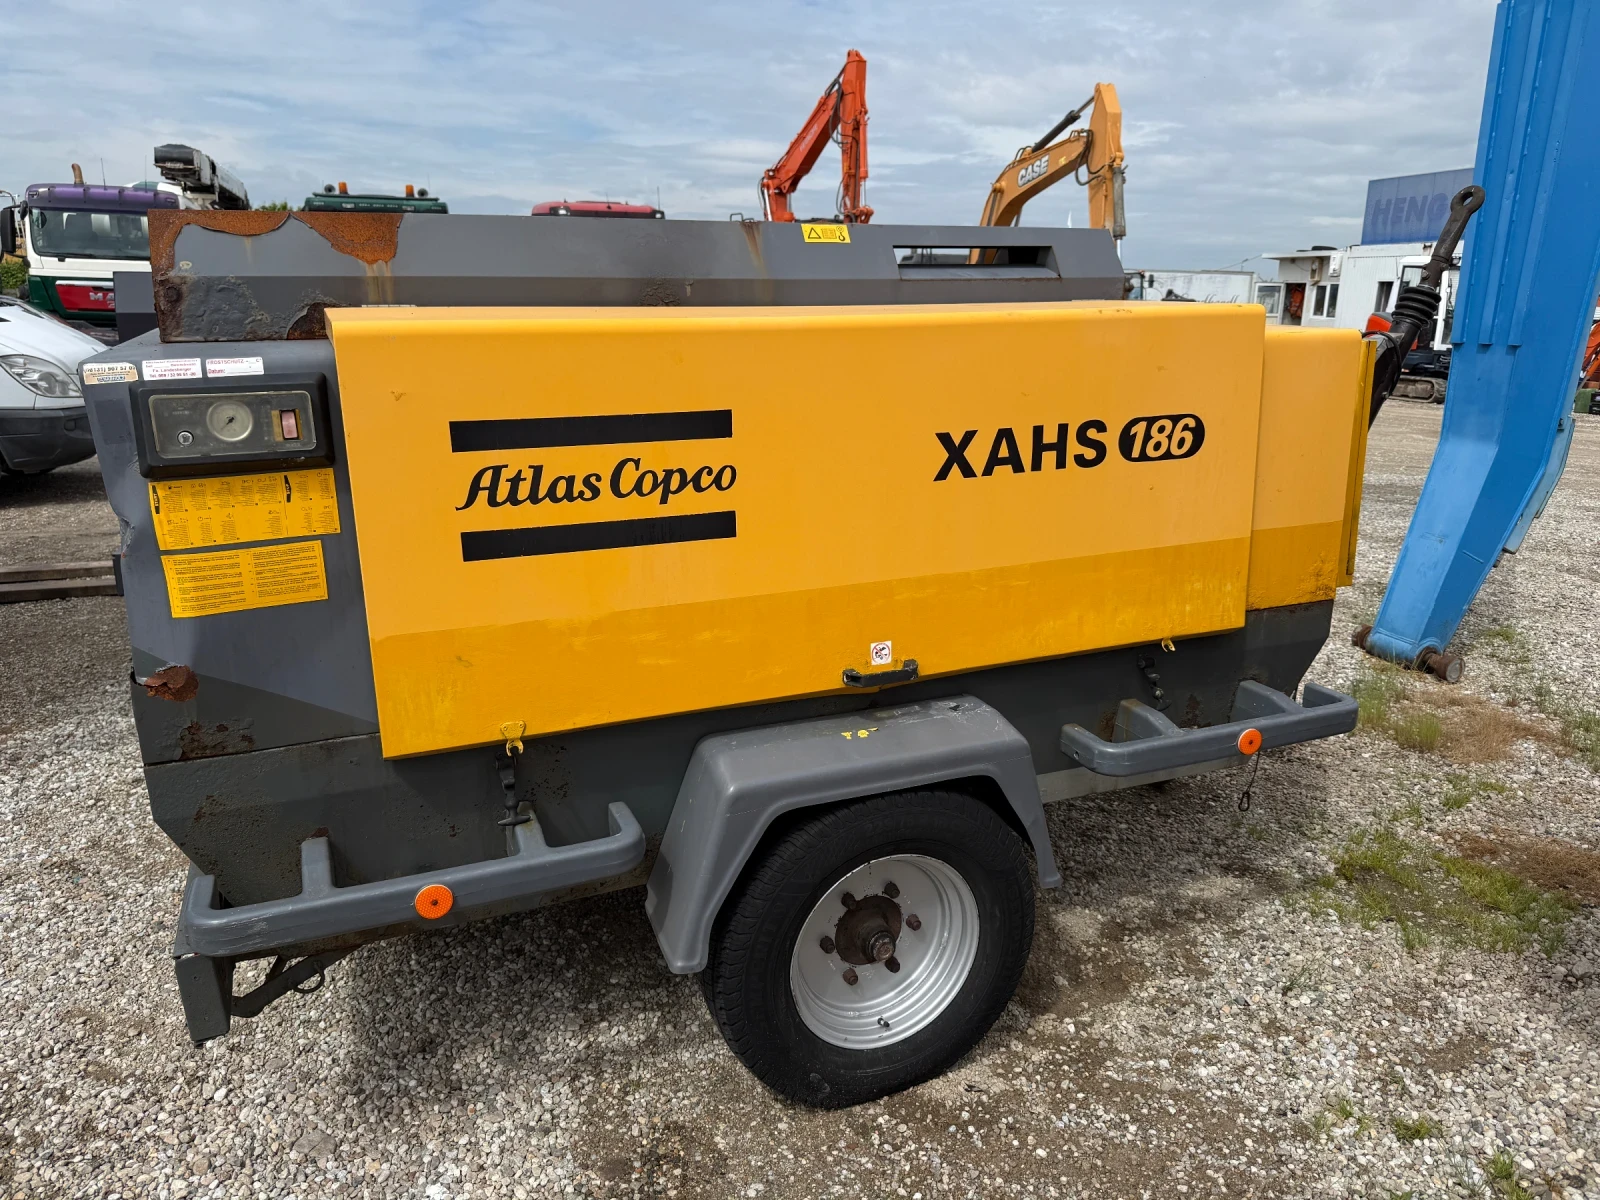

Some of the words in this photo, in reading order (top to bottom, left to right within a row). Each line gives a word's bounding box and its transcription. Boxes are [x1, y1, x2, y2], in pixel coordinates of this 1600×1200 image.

[1018, 155, 1050, 188] CASE
[933, 419, 1108, 482] XAHS
[1128, 417, 1197, 459] 186
[455, 464, 603, 511] Atlas
[609, 457, 737, 505] Copco
